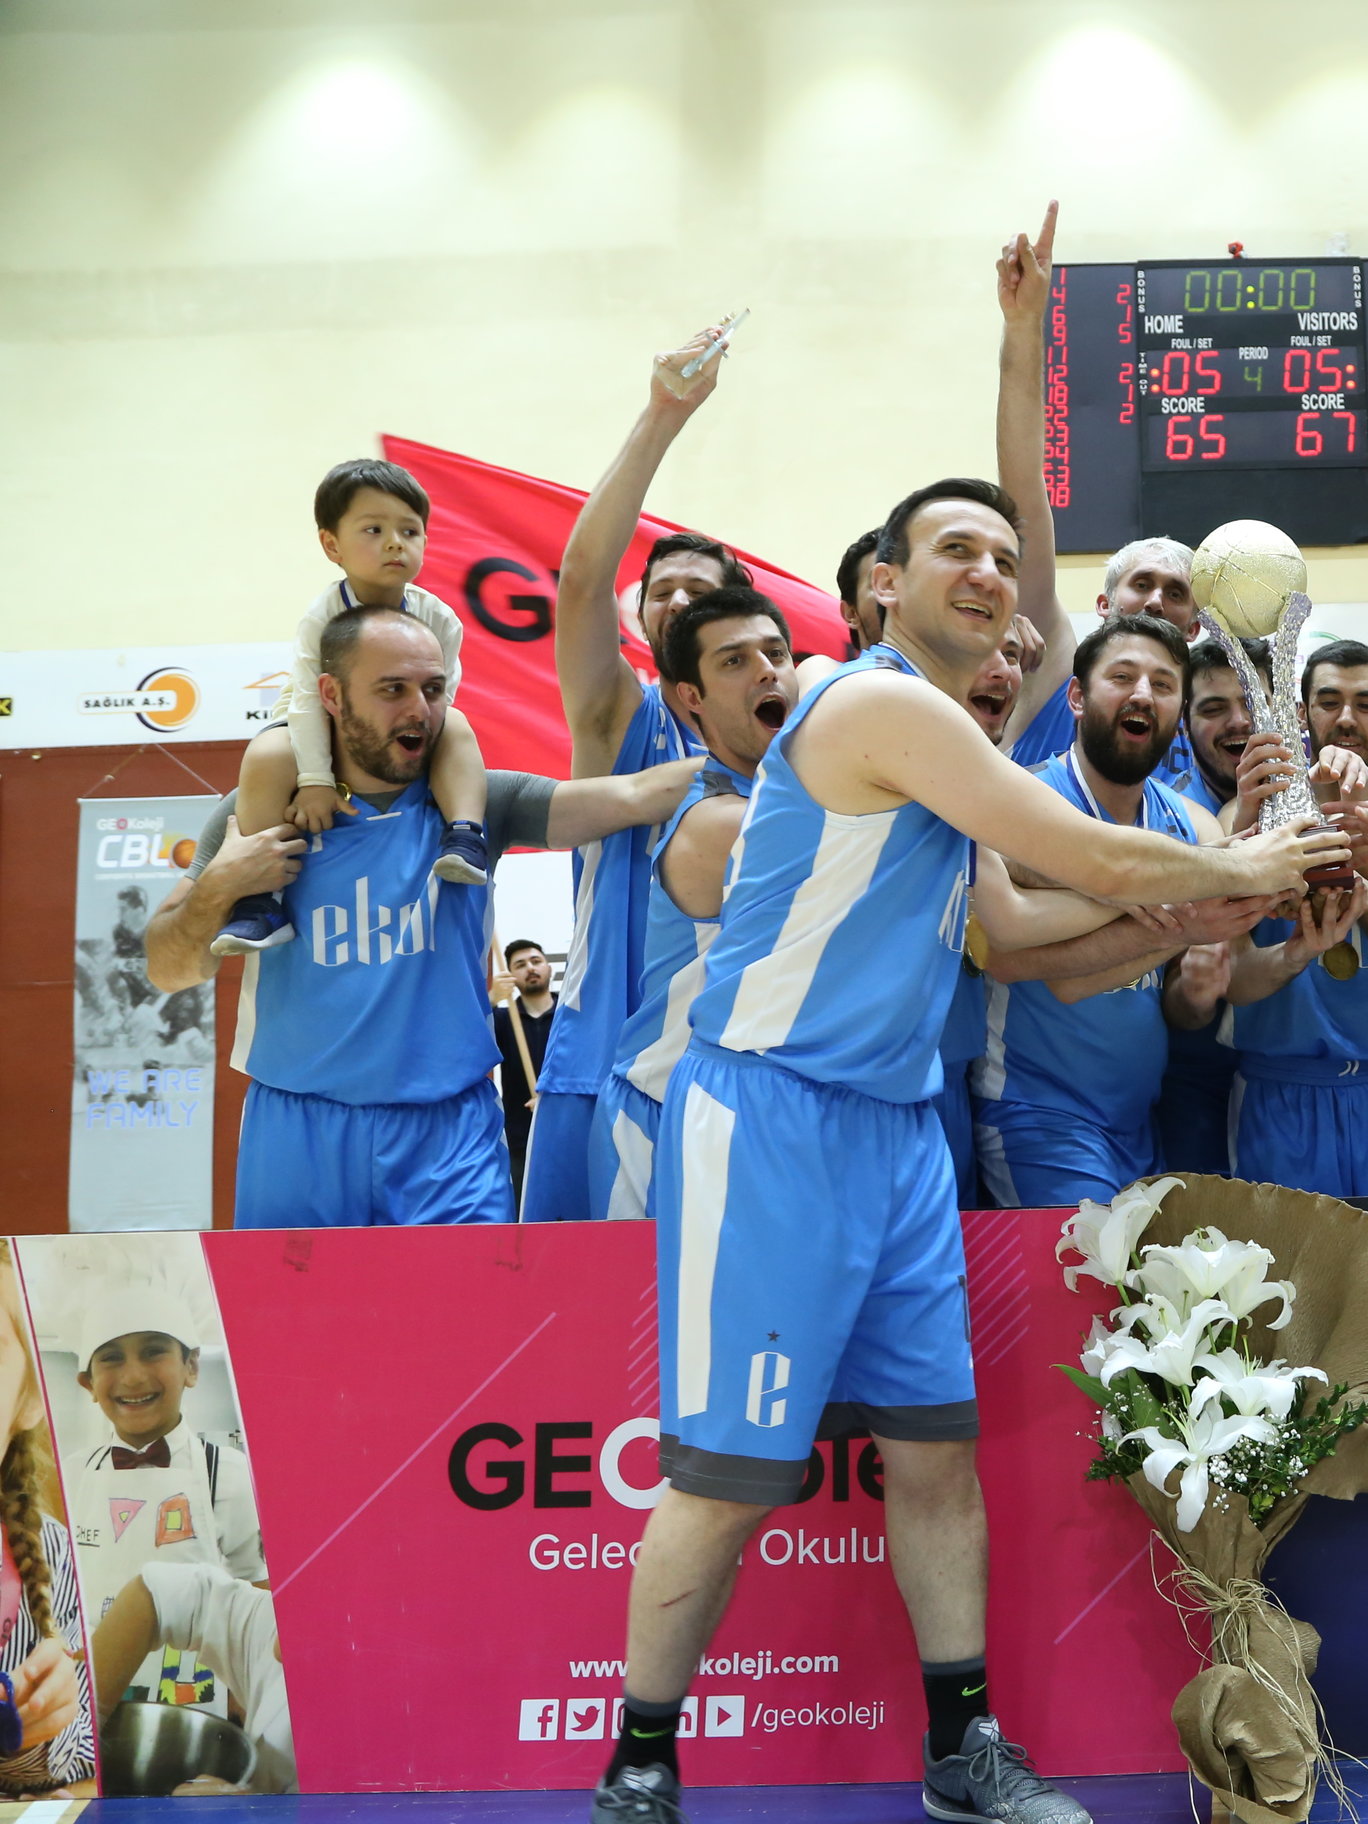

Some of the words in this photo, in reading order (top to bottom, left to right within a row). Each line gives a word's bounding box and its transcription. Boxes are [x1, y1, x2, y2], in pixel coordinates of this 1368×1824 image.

[1052, 287, 1066, 304] 4
[1116, 284, 1131, 304] 2
[1137, 270, 1146, 313] BONUS
[1184, 269, 1316, 312] 00:00
[1353, 266, 1362, 308] BONUS
[1052, 305, 1066, 325] 6
[1145, 315, 1184, 334] HOME
[1298, 312, 1358, 331] VISITORS
[1118, 324, 1132, 344] 5
[1171, 338, 1193, 349] FOUL
[1198, 337, 1213, 348] SET
[1290, 336, 1311, 346] FOUL
[1317, 335, 1332, 346] SET
[1239, 347, 1268, 360] PERIOD
[1162, 350, 1222, 395] 05
[1244, 366, 1262, 392] 4
[1283, 348, 1343, 393] 05
[1161, 397, 1205, 414] SCORE
[1301, 394, 1345, 410] SCORE
[1166, 414, 1227, 460] 65
[1296, 411, 1356, 457] 67
[84, 697, 135, 709] SAĞLIK
[97, 834, 170, 869] CBL
[87, 1069, 130, 1094] WE
[143, 1069, 202, 1092] ARE
[86, 1101, 199, 1129] FAMILY
[759, 1527, 885, 1566] Okulu
